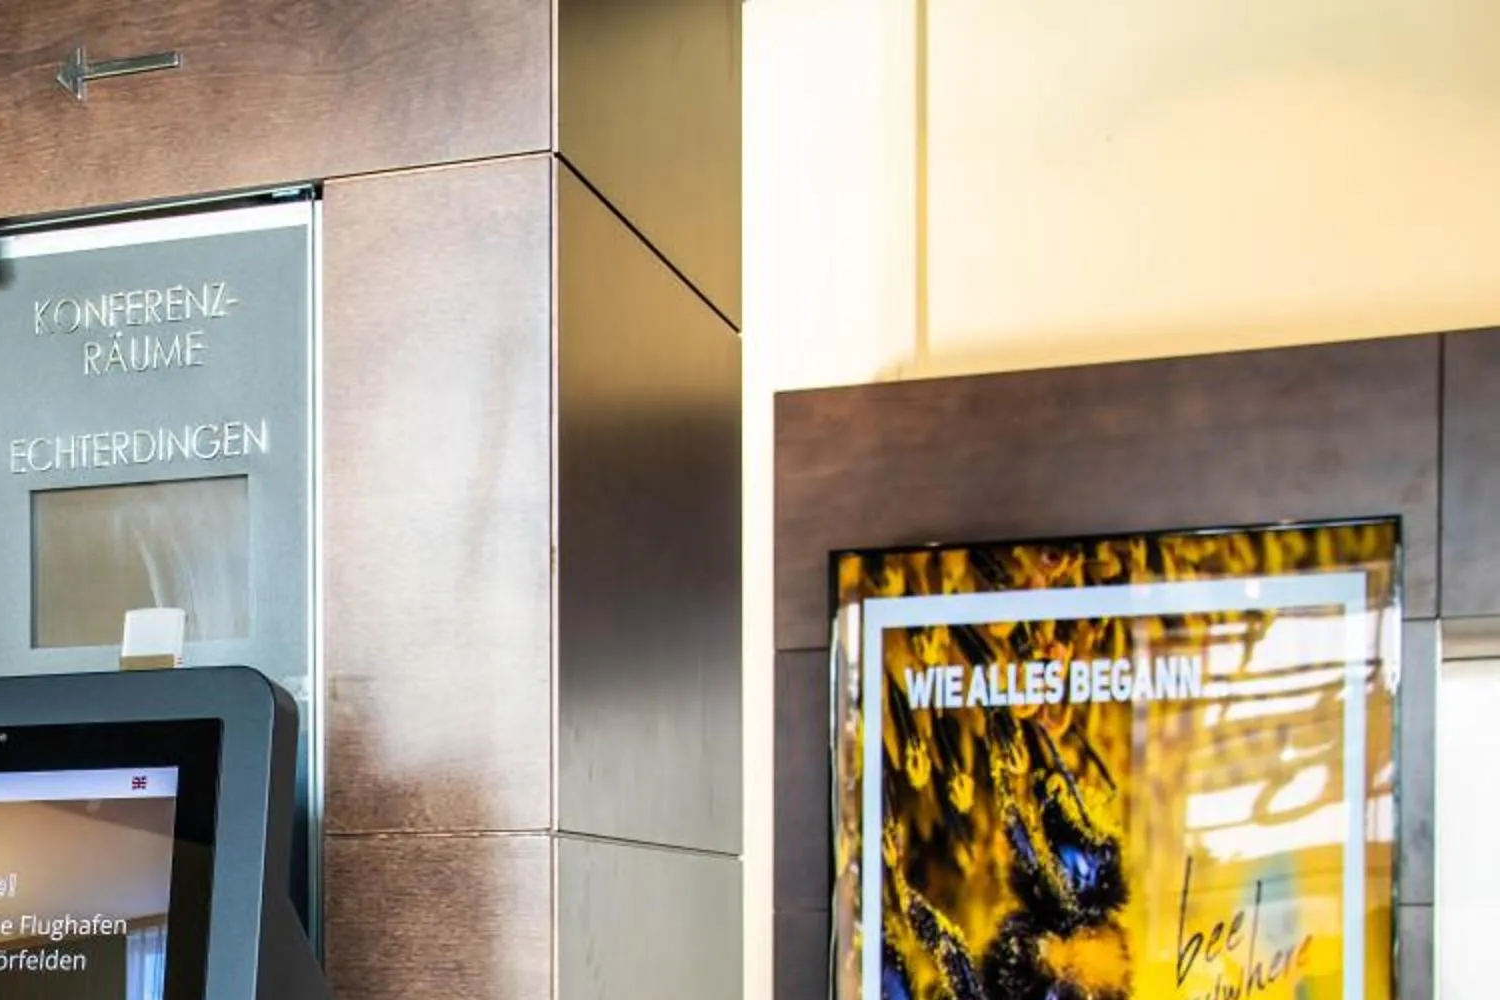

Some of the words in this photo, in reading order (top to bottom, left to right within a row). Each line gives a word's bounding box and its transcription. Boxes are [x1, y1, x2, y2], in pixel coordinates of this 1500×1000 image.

[34, 282, 240, 336] KONFERENZ-
[83, 331, 209, 375] RÄUME
[10, 419, 270, 474] ECHTERDINGEN
[904, 664, 963, 709] WIE
[967, 659, 1064, 707] ALLES
[19, 914, 127, 941] Flughafen
[1177, 856, 1244, 988] bee
